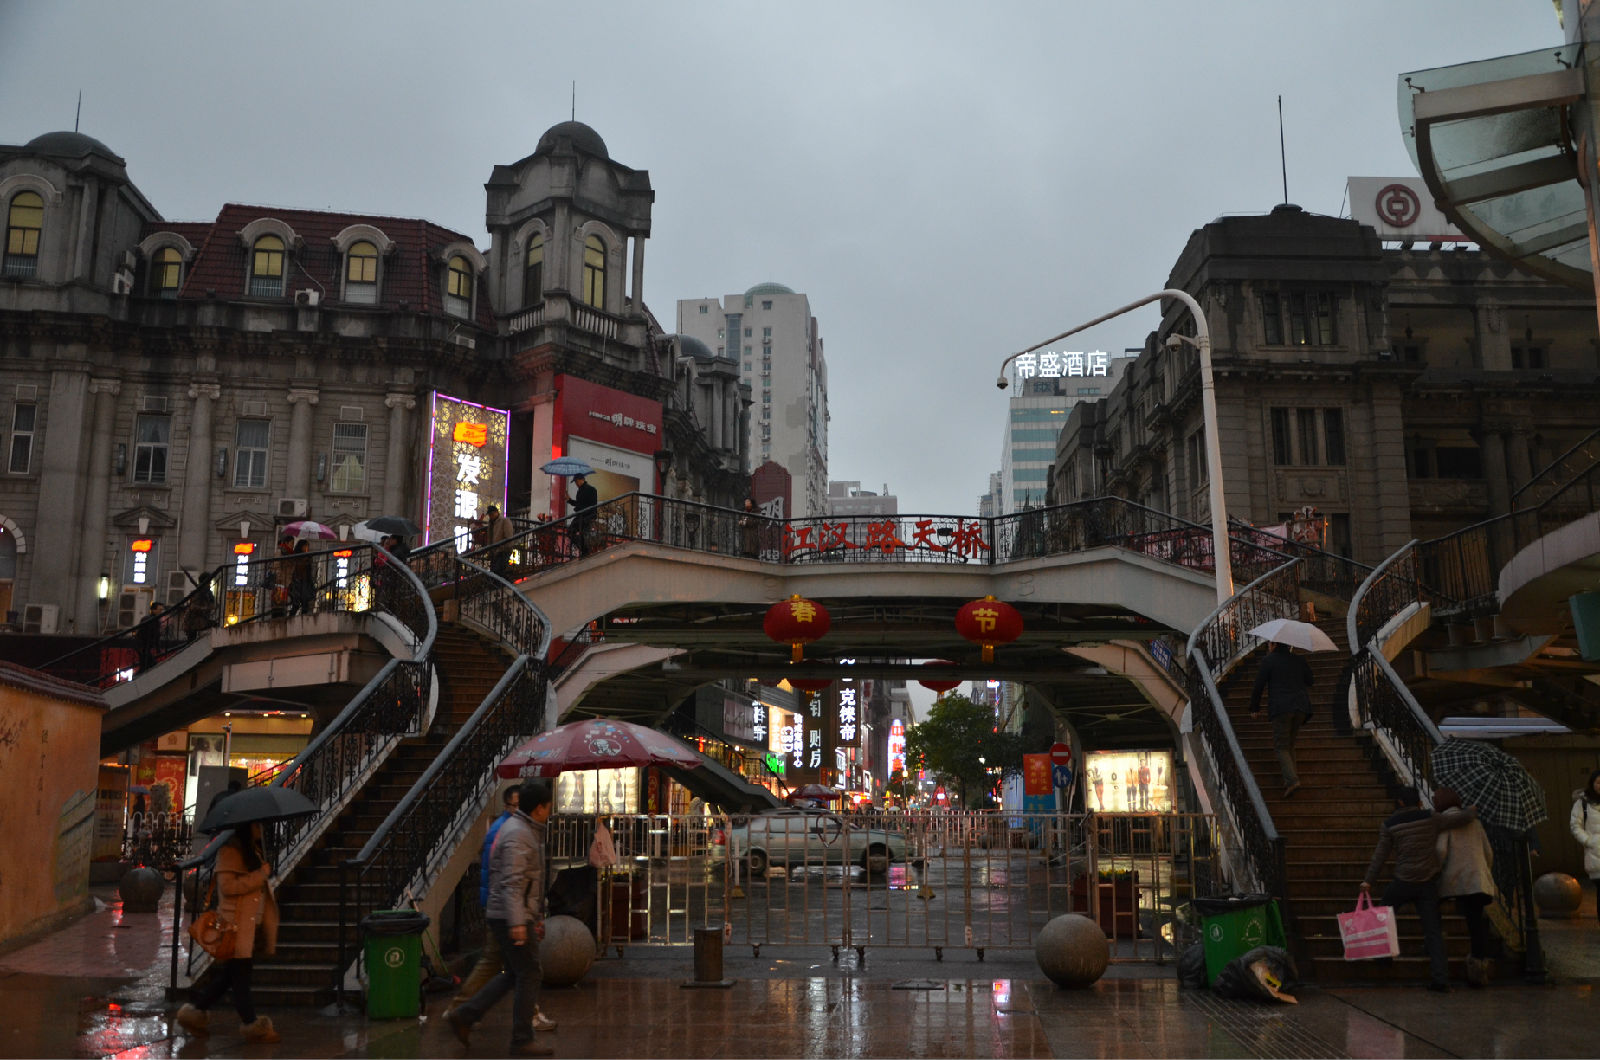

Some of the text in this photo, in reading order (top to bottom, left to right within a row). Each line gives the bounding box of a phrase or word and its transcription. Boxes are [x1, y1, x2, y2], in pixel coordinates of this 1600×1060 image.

[1015, 349, 1107, 379] 帝盛酒店
[783, 518, 991, 558] 江汉路天桥
[790, 601, 816, 623] 春
[972, 608, 998, 633] 节
